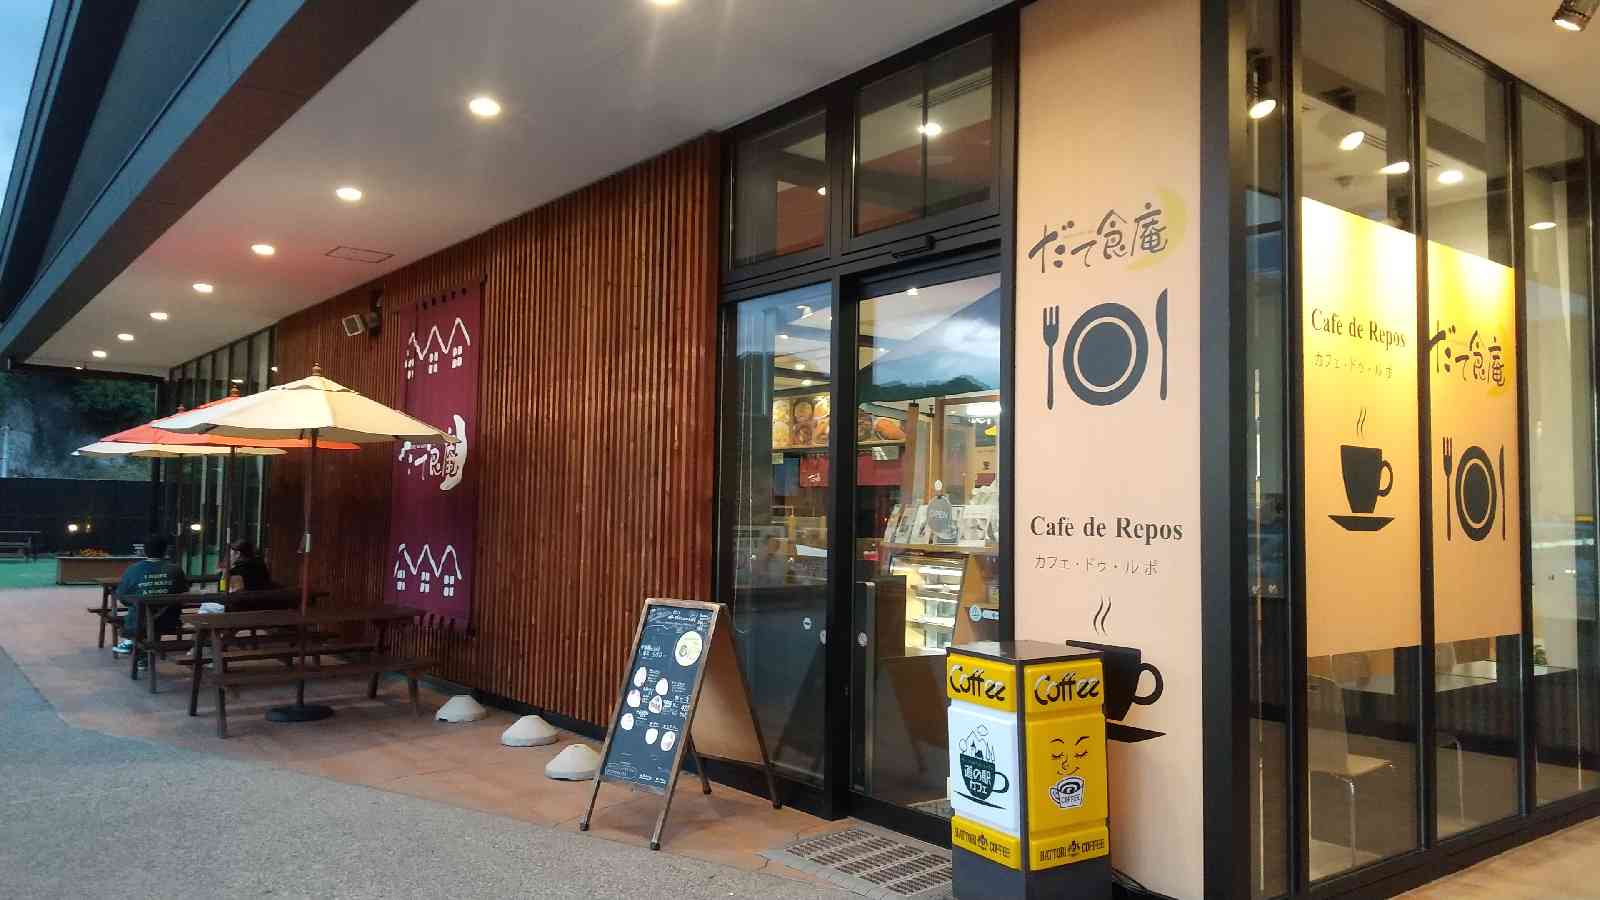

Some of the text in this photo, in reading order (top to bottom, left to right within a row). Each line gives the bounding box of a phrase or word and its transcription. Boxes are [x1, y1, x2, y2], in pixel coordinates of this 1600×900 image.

[1028, 202, 1168, 274] だて食庵
[1348, 316, 1364, 339] de
[1369, 320, 1406, 351] Repos
[1083, 516, 1106, 537] de
[1115, 517, 1184, 546] Repos
[950, 664, 1006, 702] Coffee
[1034, 672, 1100, 706] Coffee
